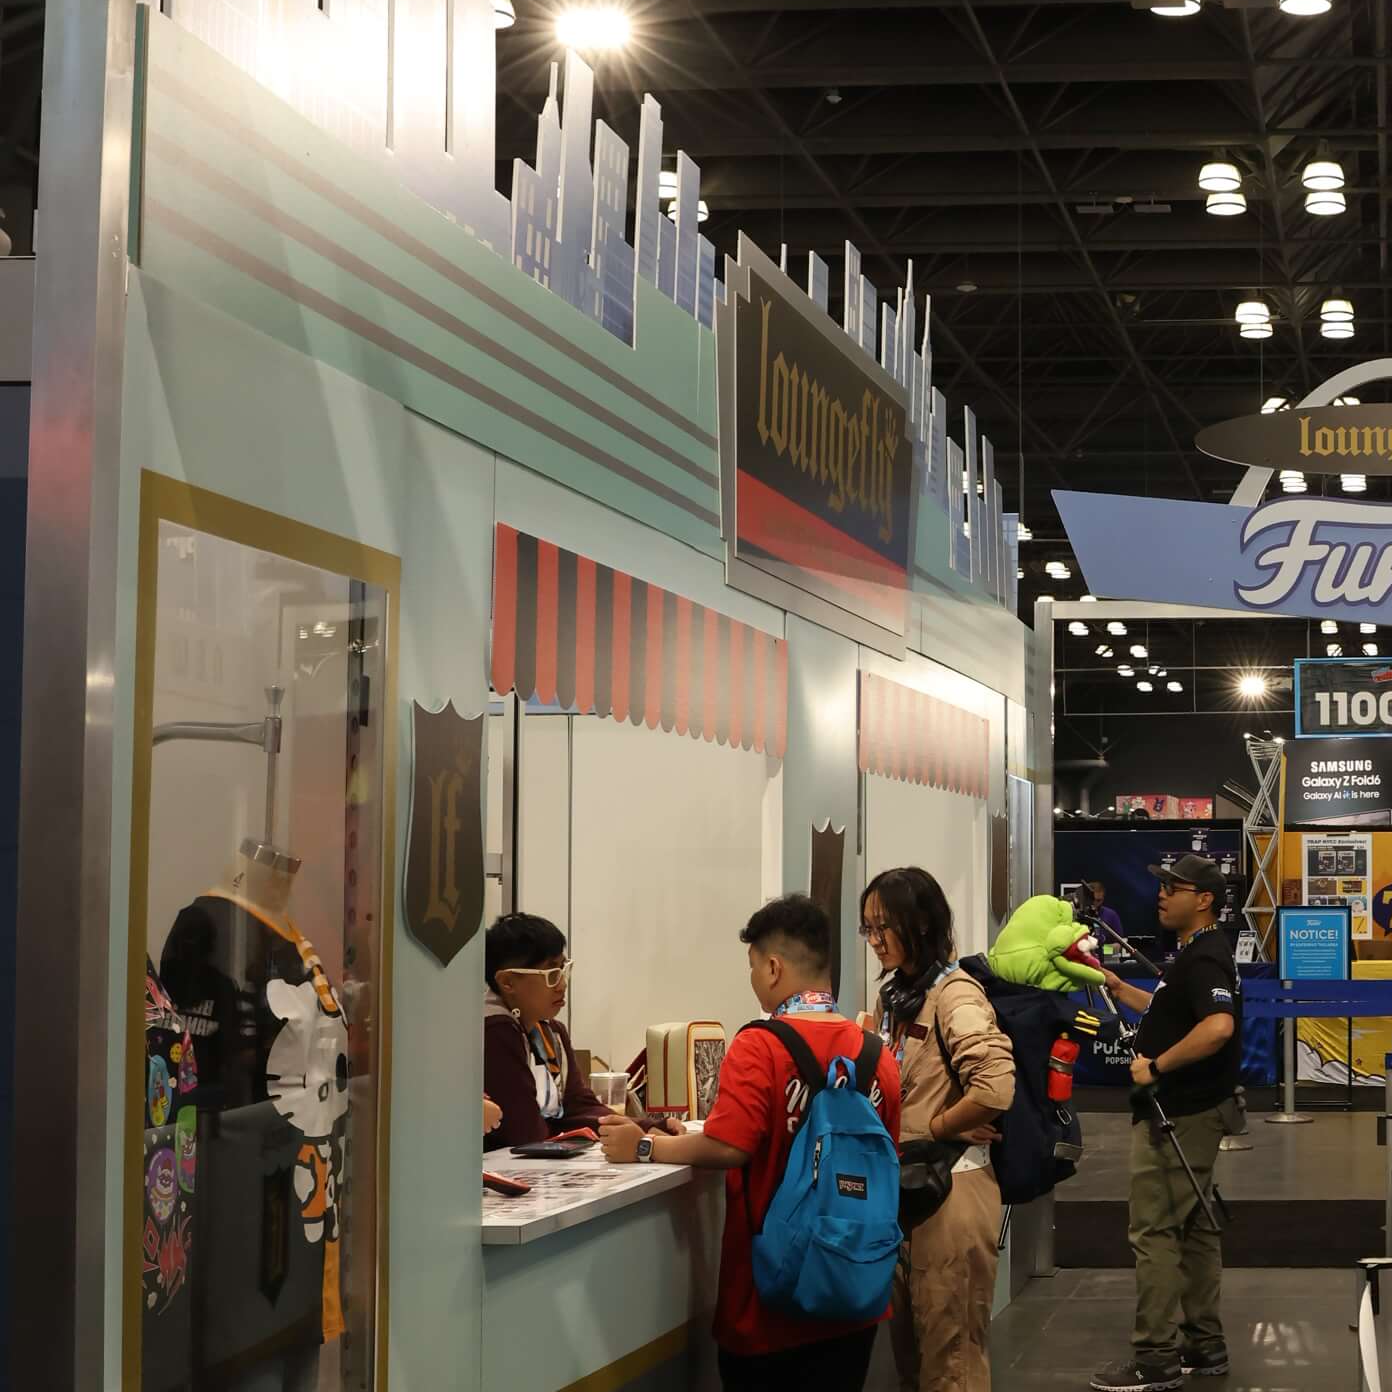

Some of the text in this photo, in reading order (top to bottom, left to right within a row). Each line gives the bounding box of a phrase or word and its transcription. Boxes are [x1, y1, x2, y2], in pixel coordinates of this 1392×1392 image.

[756, 296, 893, 544] loungefly
[1310, 760, 1372, 773] SAMSUNG
[1302, 775, 1381, 789] Galaxy Z Fold6
[1303, 792, 1333, 802] Galaxy
[1351, 790, 1358, 799] is
[1359, 790, 1380, 799] here
[1290, 929, 1338, 939] NOTICE!
[1105, 1056, 1132, 1064] POPSHI
